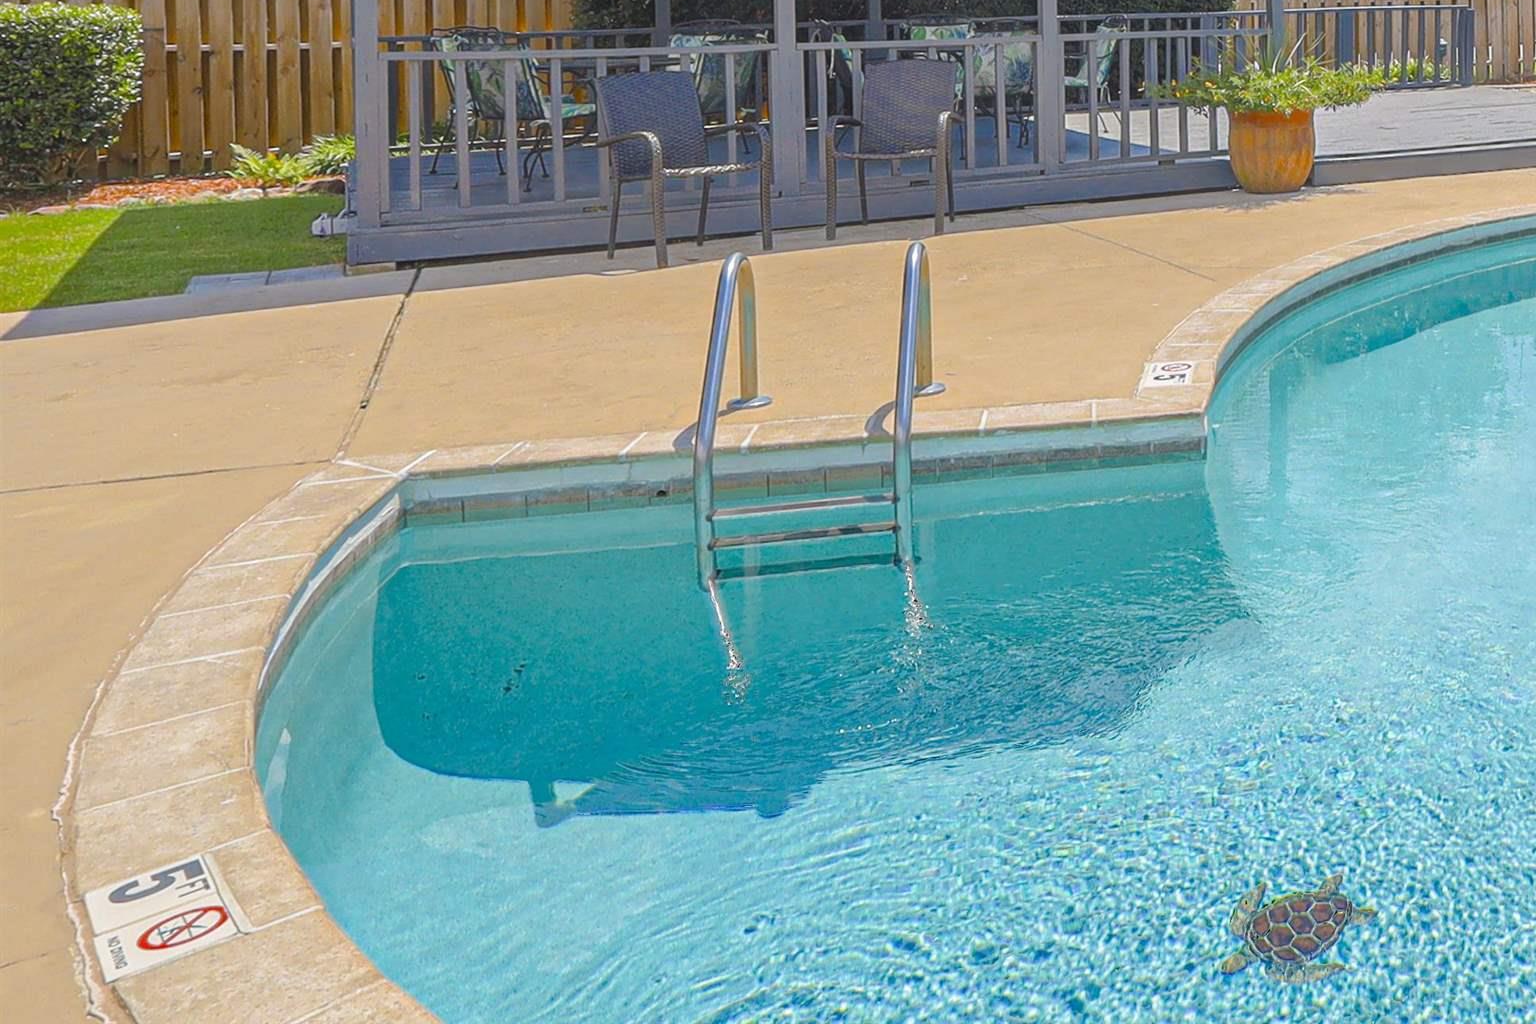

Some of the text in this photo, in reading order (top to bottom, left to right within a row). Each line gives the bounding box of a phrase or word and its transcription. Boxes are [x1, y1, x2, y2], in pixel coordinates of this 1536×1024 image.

[1153, 373, 1186, 381] 5
[108, 859, 205, 904] 5
[175, 878, 211, 898] FT
[107, 935, 128, 970] NO DIVING
